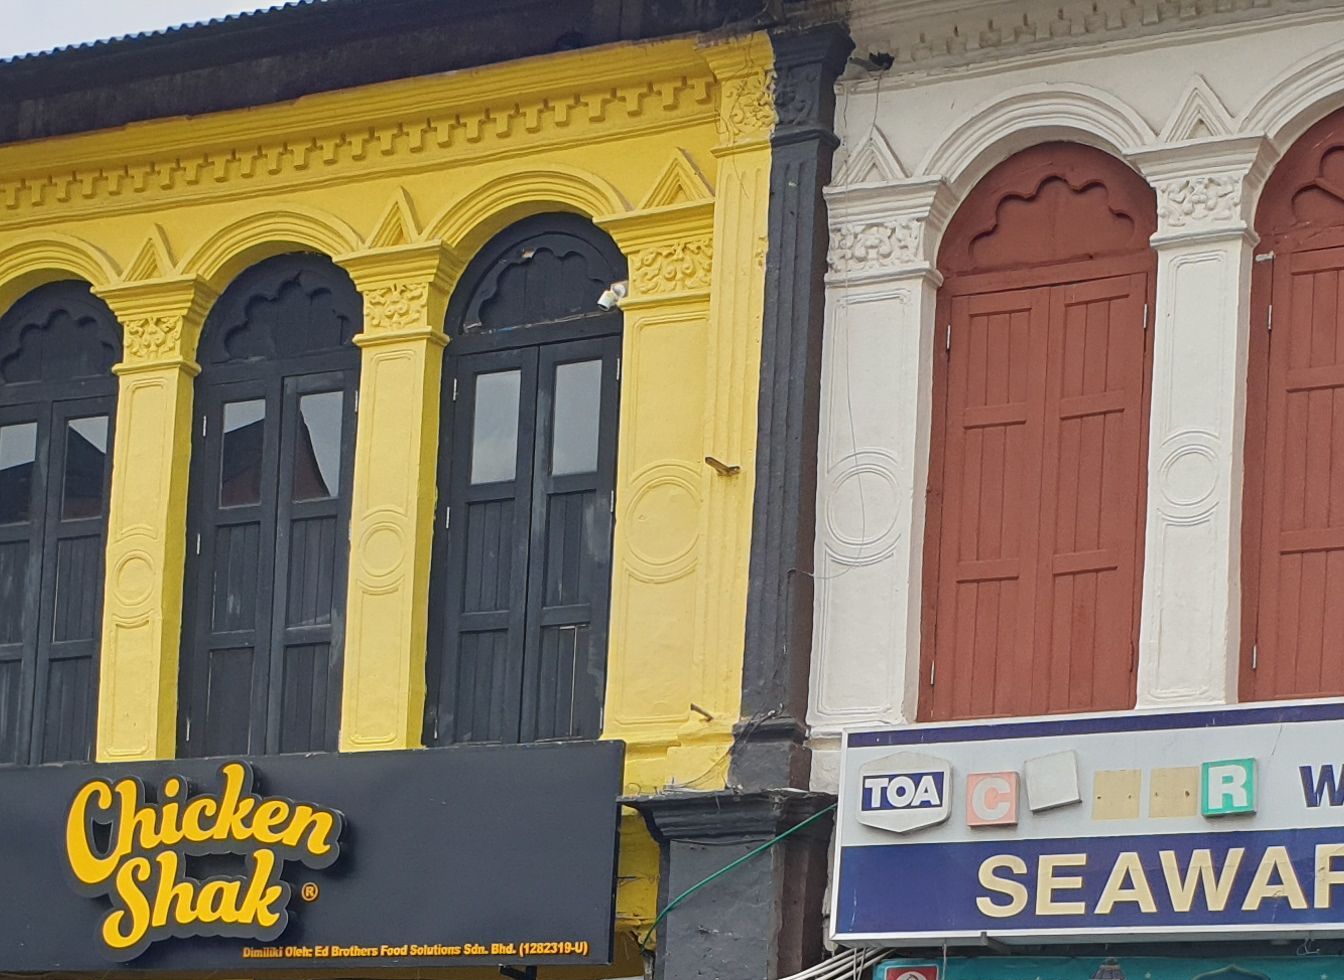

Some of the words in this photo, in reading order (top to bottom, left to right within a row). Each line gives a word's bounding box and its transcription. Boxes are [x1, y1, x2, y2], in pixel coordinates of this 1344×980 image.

[66, 763, 335, 884] Chicken
[864, 775, 944, 808] TOA
[102, 850, 283, 948] Shak
[315, 945, 329, 957] Ed
[331, 944, 378, 957] Brothers
[380, 943, 408, 957] Food
[409, 942, 461, 956] Solutions
[463, 942, 488, 956] Sdn.
[490, 942, 517, 956] Bhd.
[519, 941, 588, 957] (1282319-U)
